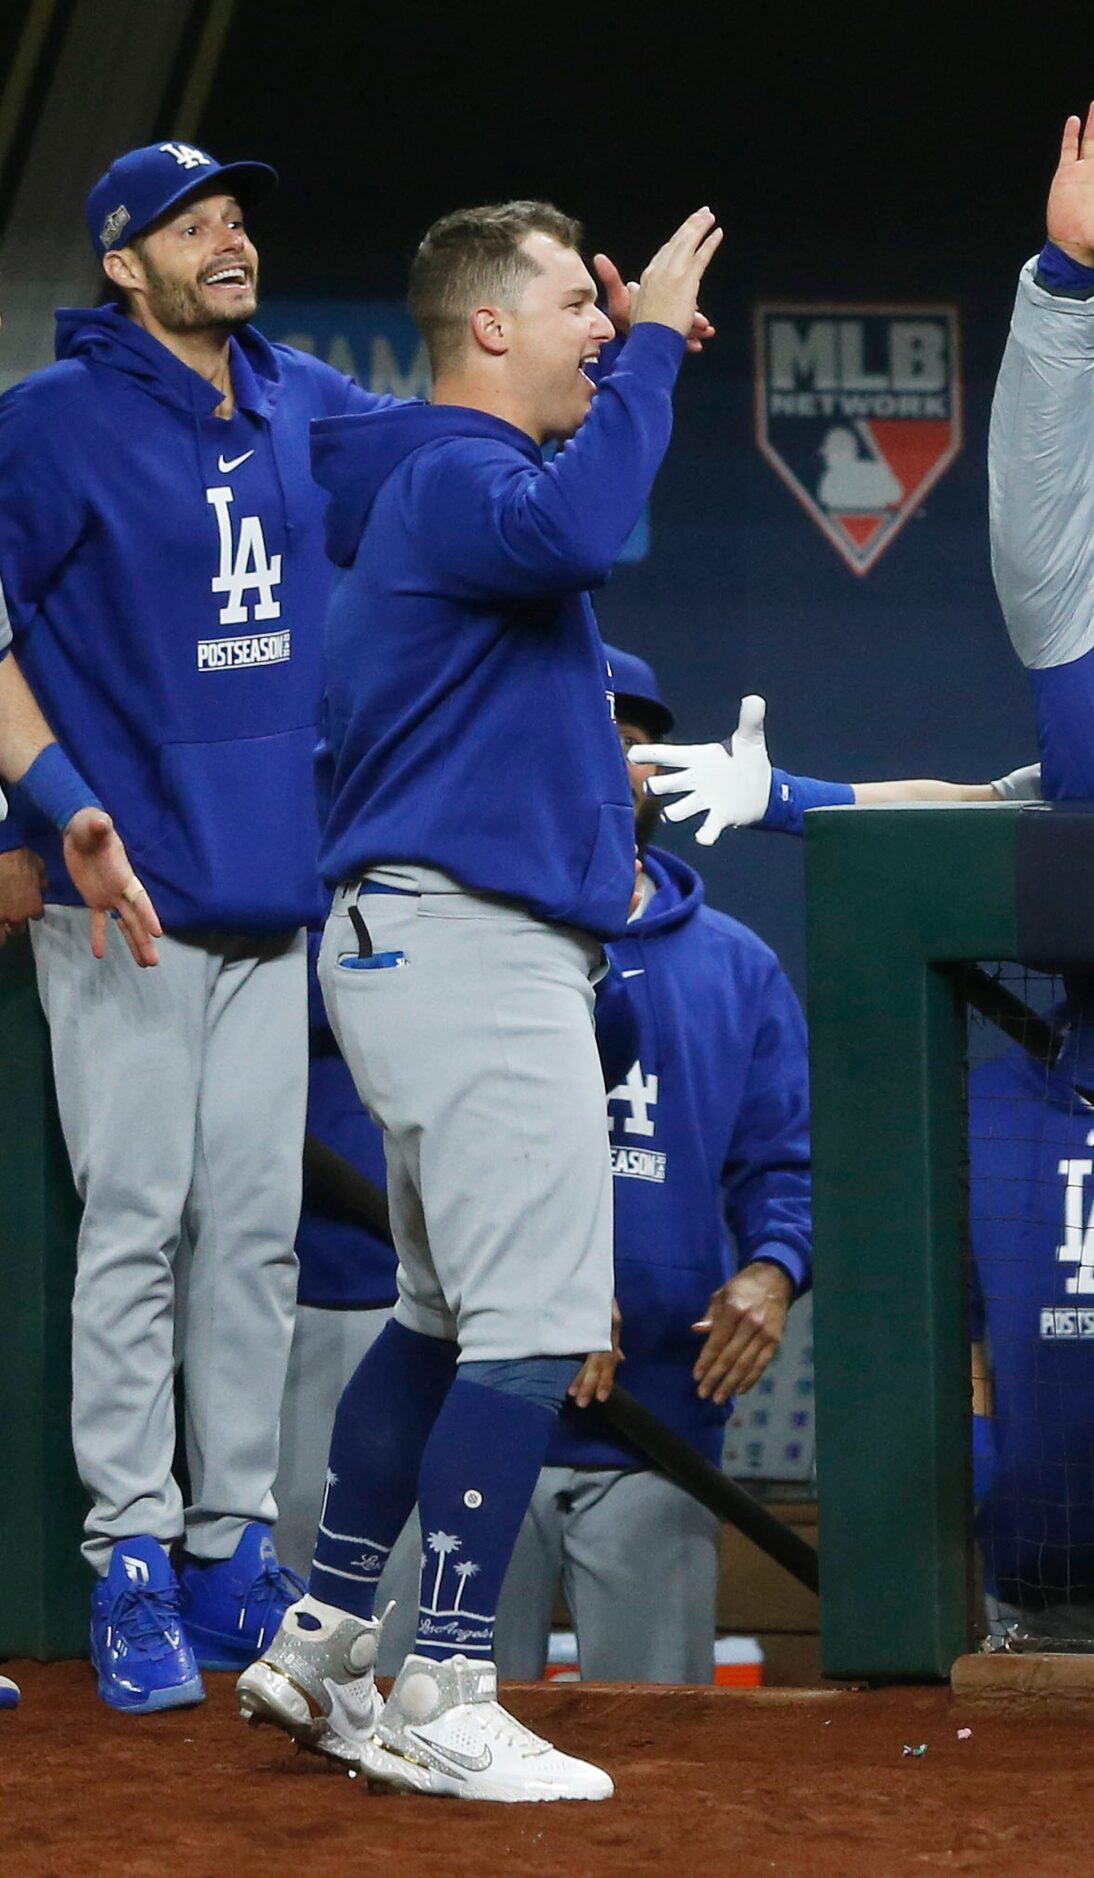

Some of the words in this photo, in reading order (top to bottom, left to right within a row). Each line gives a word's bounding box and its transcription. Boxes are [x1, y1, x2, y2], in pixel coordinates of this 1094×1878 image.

[160, 143, 211, 169] LA
[769, 321, 946, 390] MLB
[769, 394, 946, 417] NETWORK
[206, 486, 282, 625] LA
[198, 635, 284, 668] POSTSEASON
[610, 1149, 657, 1174] EASON
